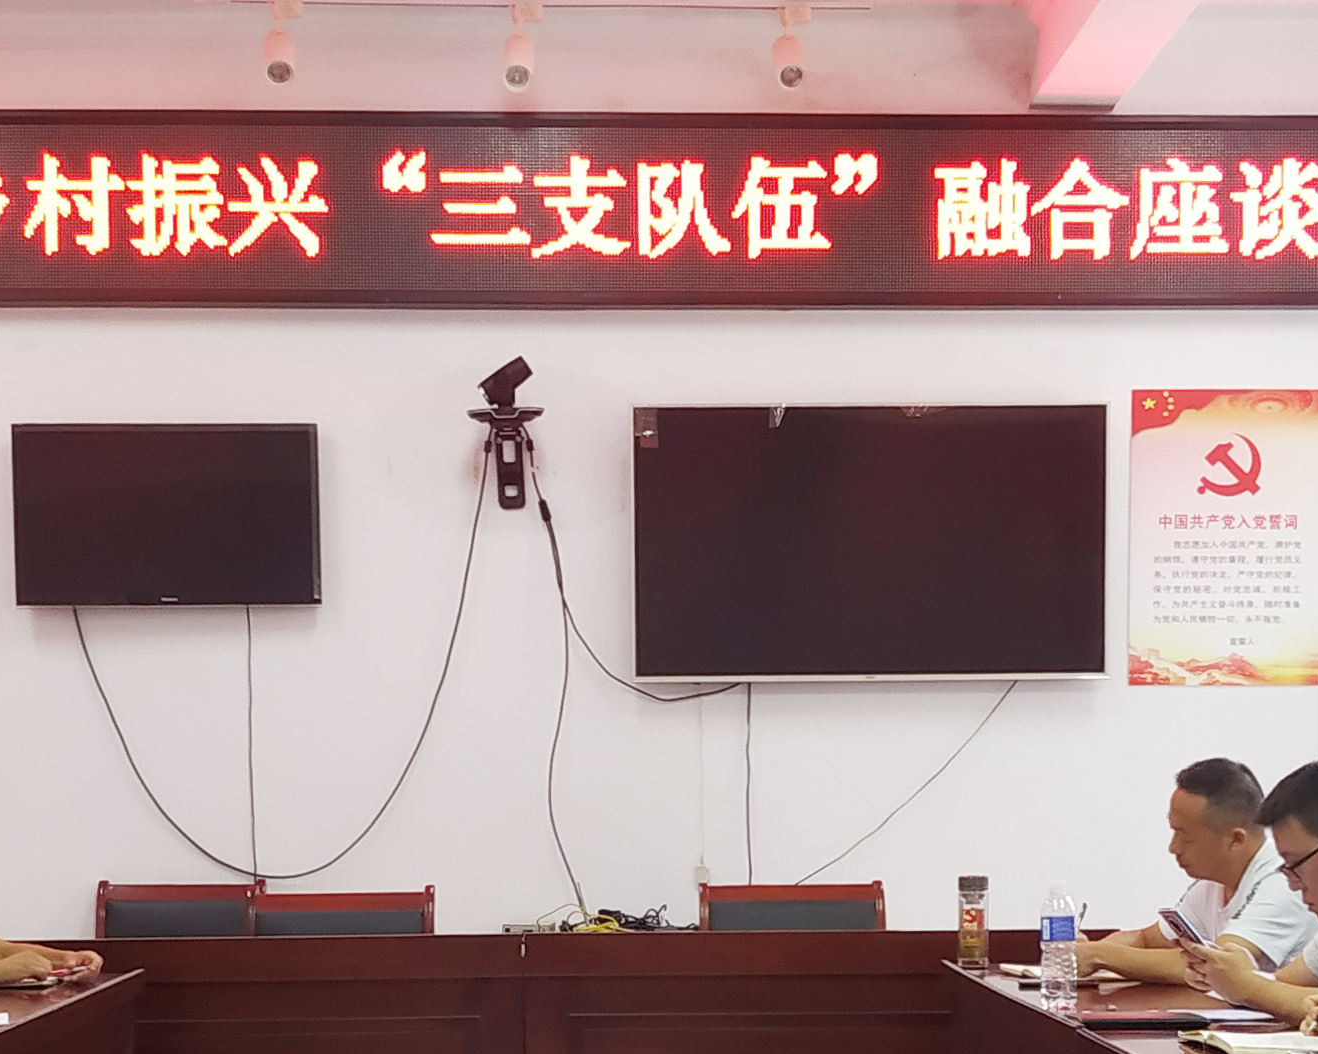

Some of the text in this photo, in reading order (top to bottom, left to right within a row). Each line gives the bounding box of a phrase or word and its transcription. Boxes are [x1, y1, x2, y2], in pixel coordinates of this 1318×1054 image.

[1158, 513, 1298, 530] 中国共产党入党誓词
